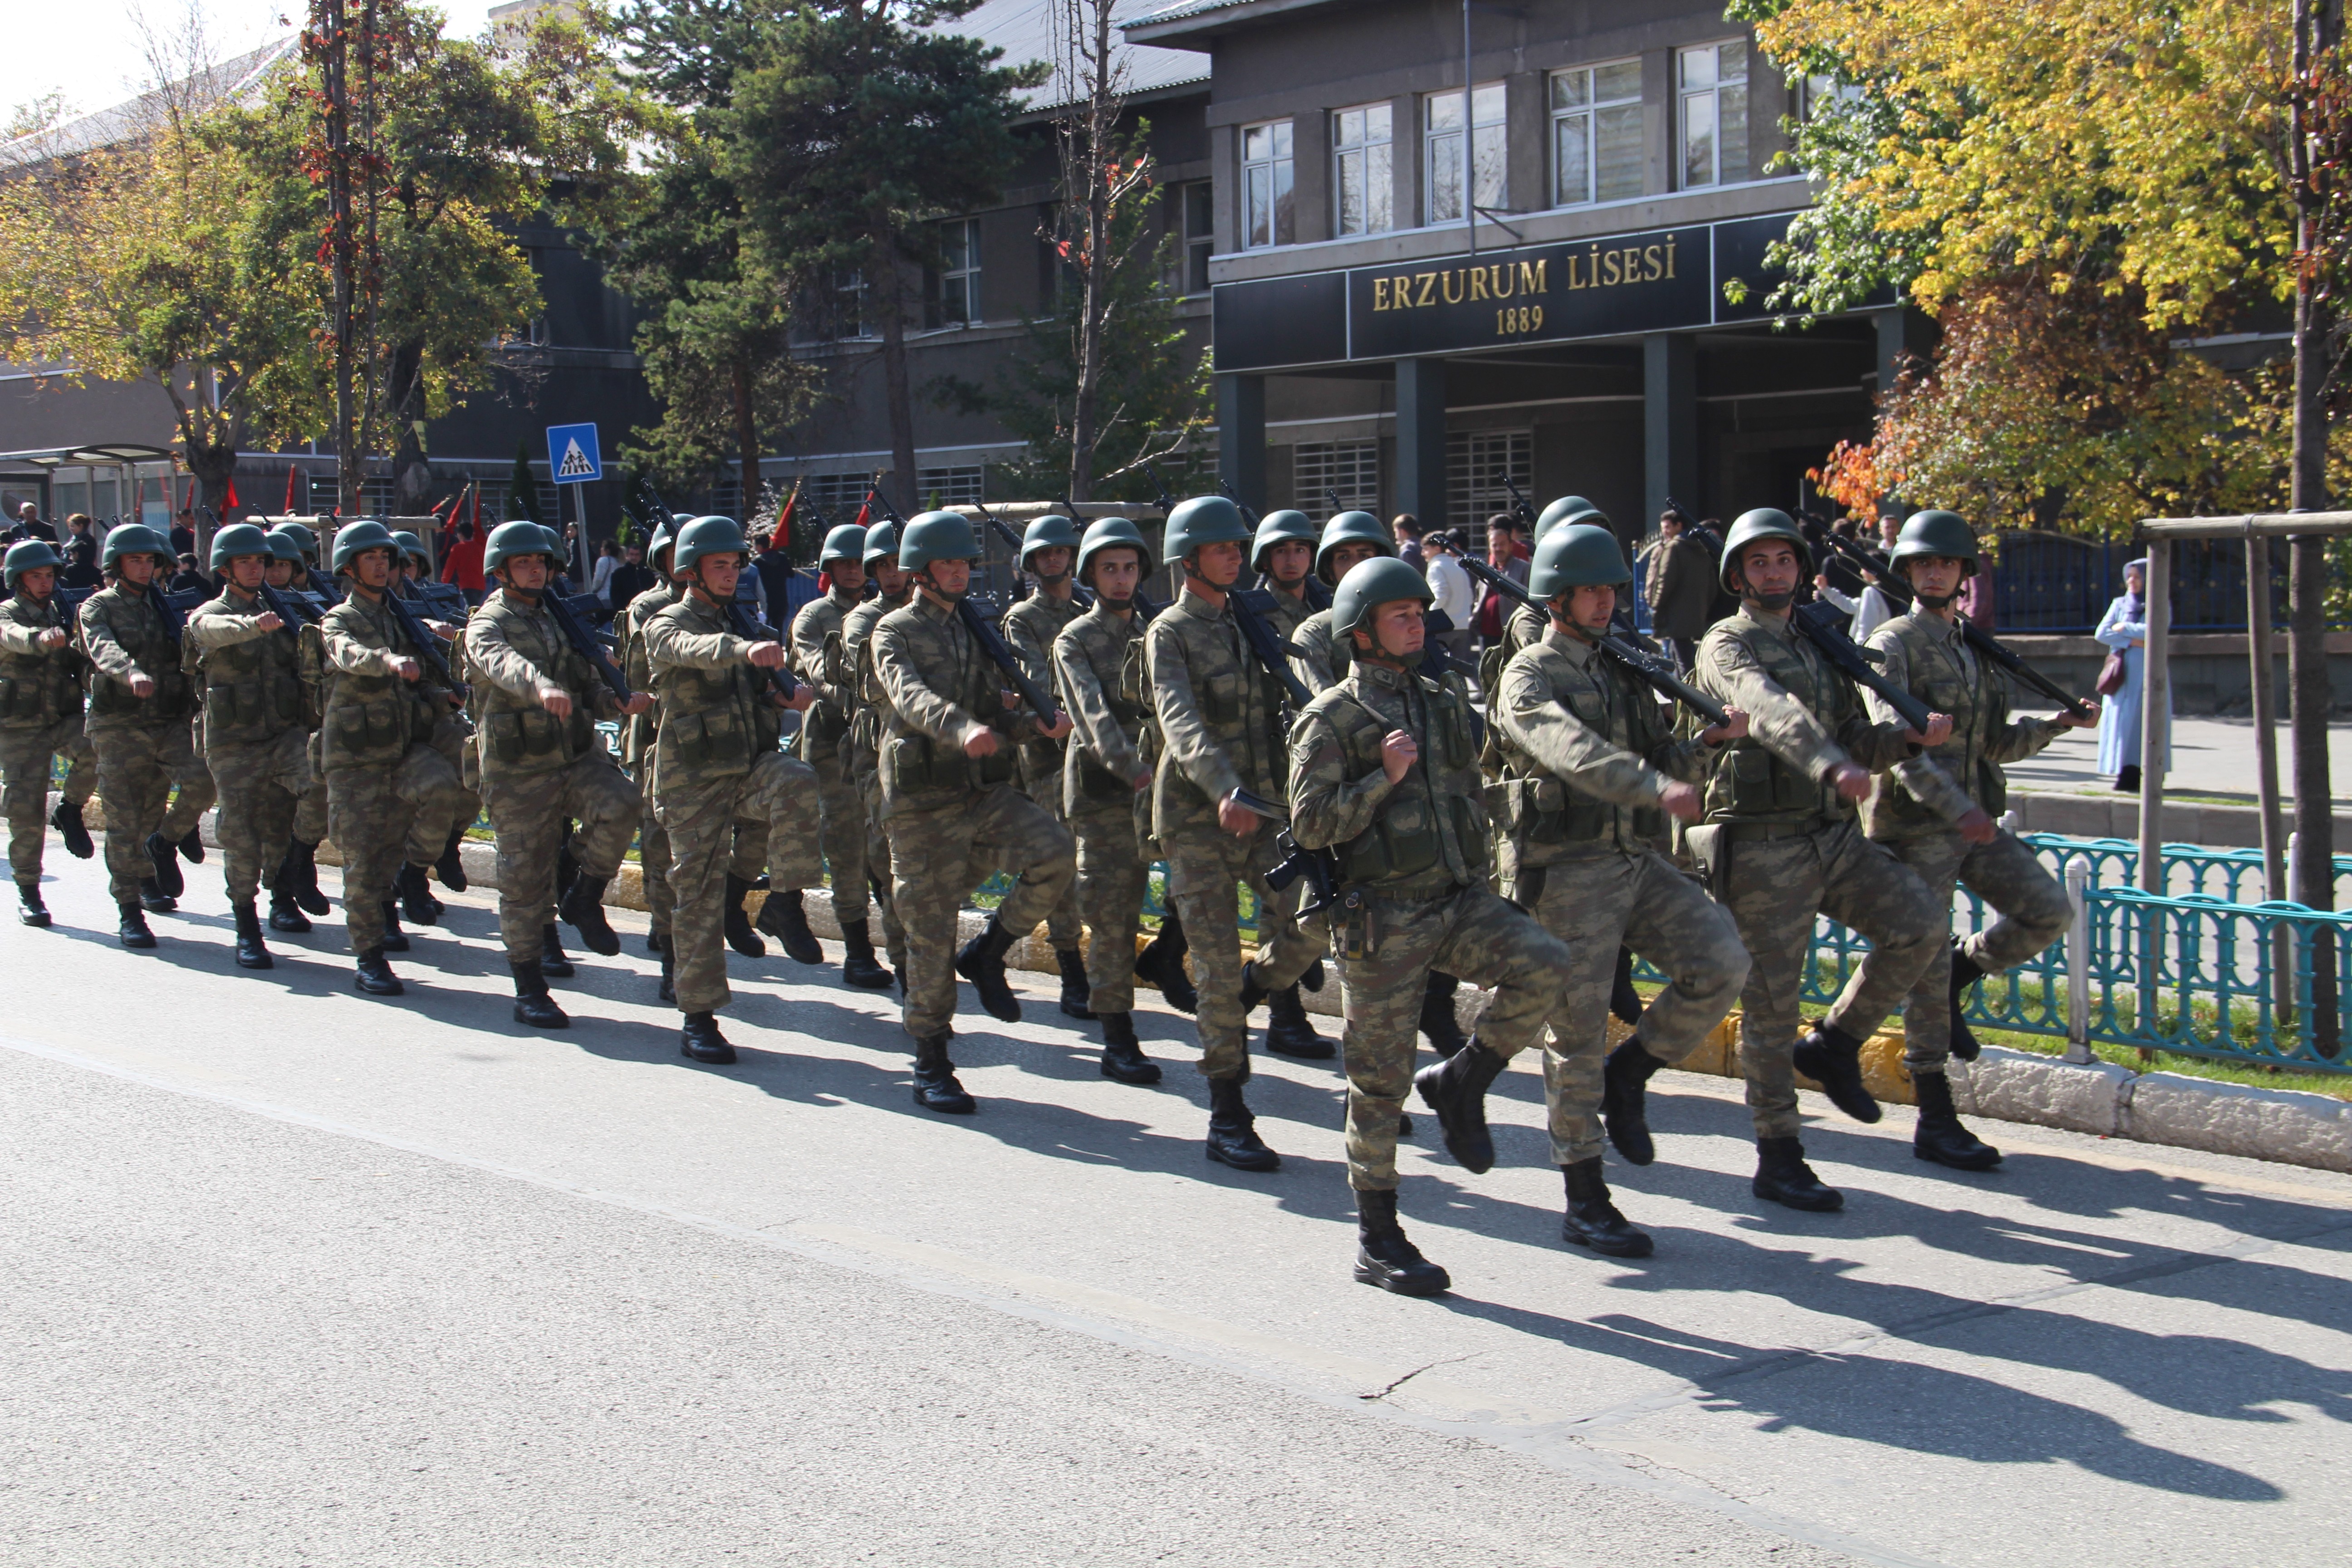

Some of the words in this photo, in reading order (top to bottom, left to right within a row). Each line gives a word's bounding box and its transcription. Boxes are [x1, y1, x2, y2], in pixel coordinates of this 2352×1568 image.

[1373, 259, 1548, 311] ERZURUM
[1567, 234, 1676, 290] LİSESİ
[1497, 305, 1543, 335] 1889
